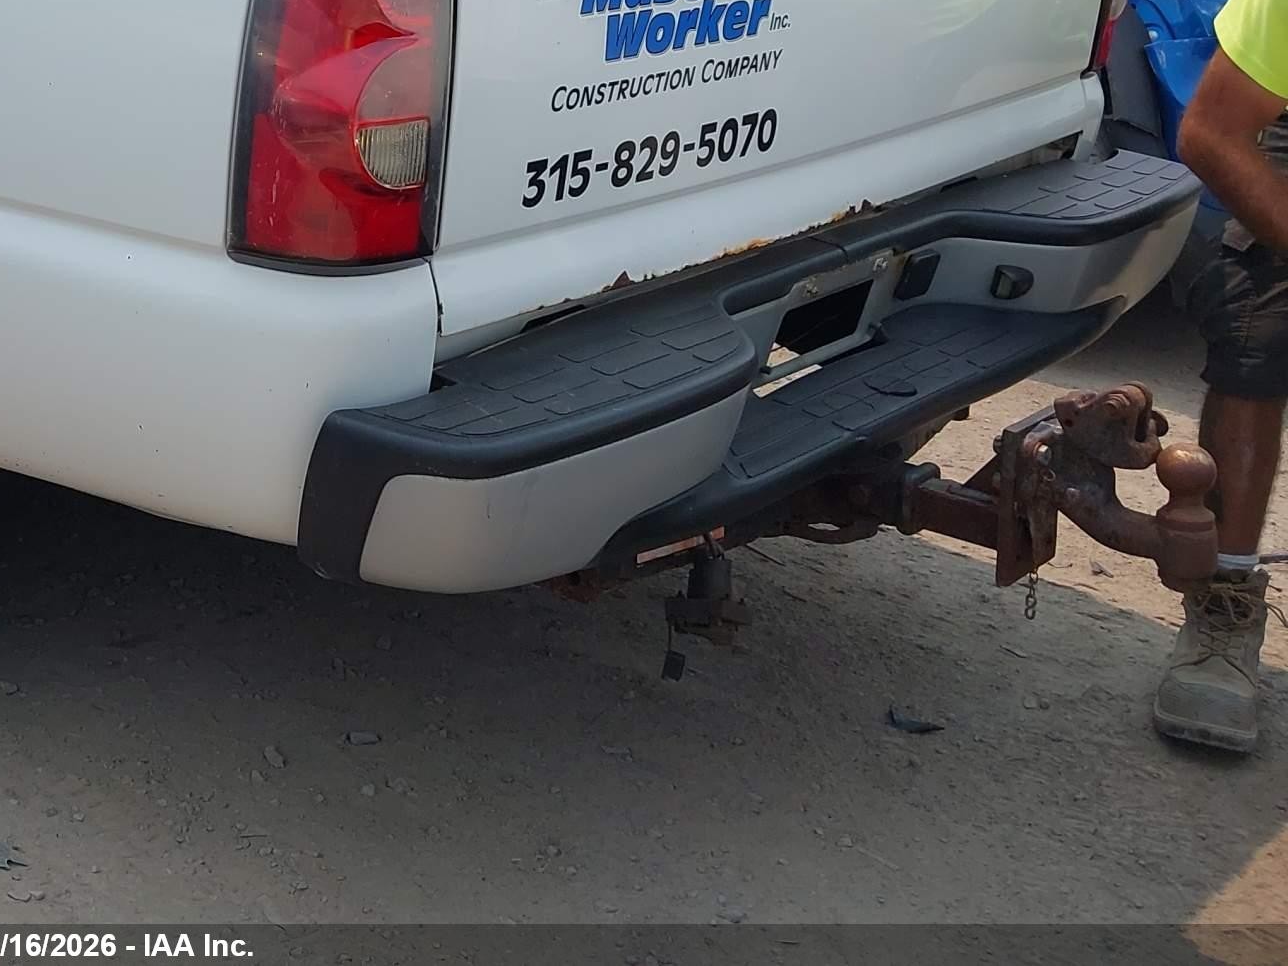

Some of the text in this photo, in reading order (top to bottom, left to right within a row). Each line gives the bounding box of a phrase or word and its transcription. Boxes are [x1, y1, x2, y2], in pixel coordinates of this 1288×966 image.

[769, 12, 791, 31] Inc.
[551, 49, 783, 112] CONSTRUCTION COMPANY
[521, 108, 777, 208] 315-829-5070
